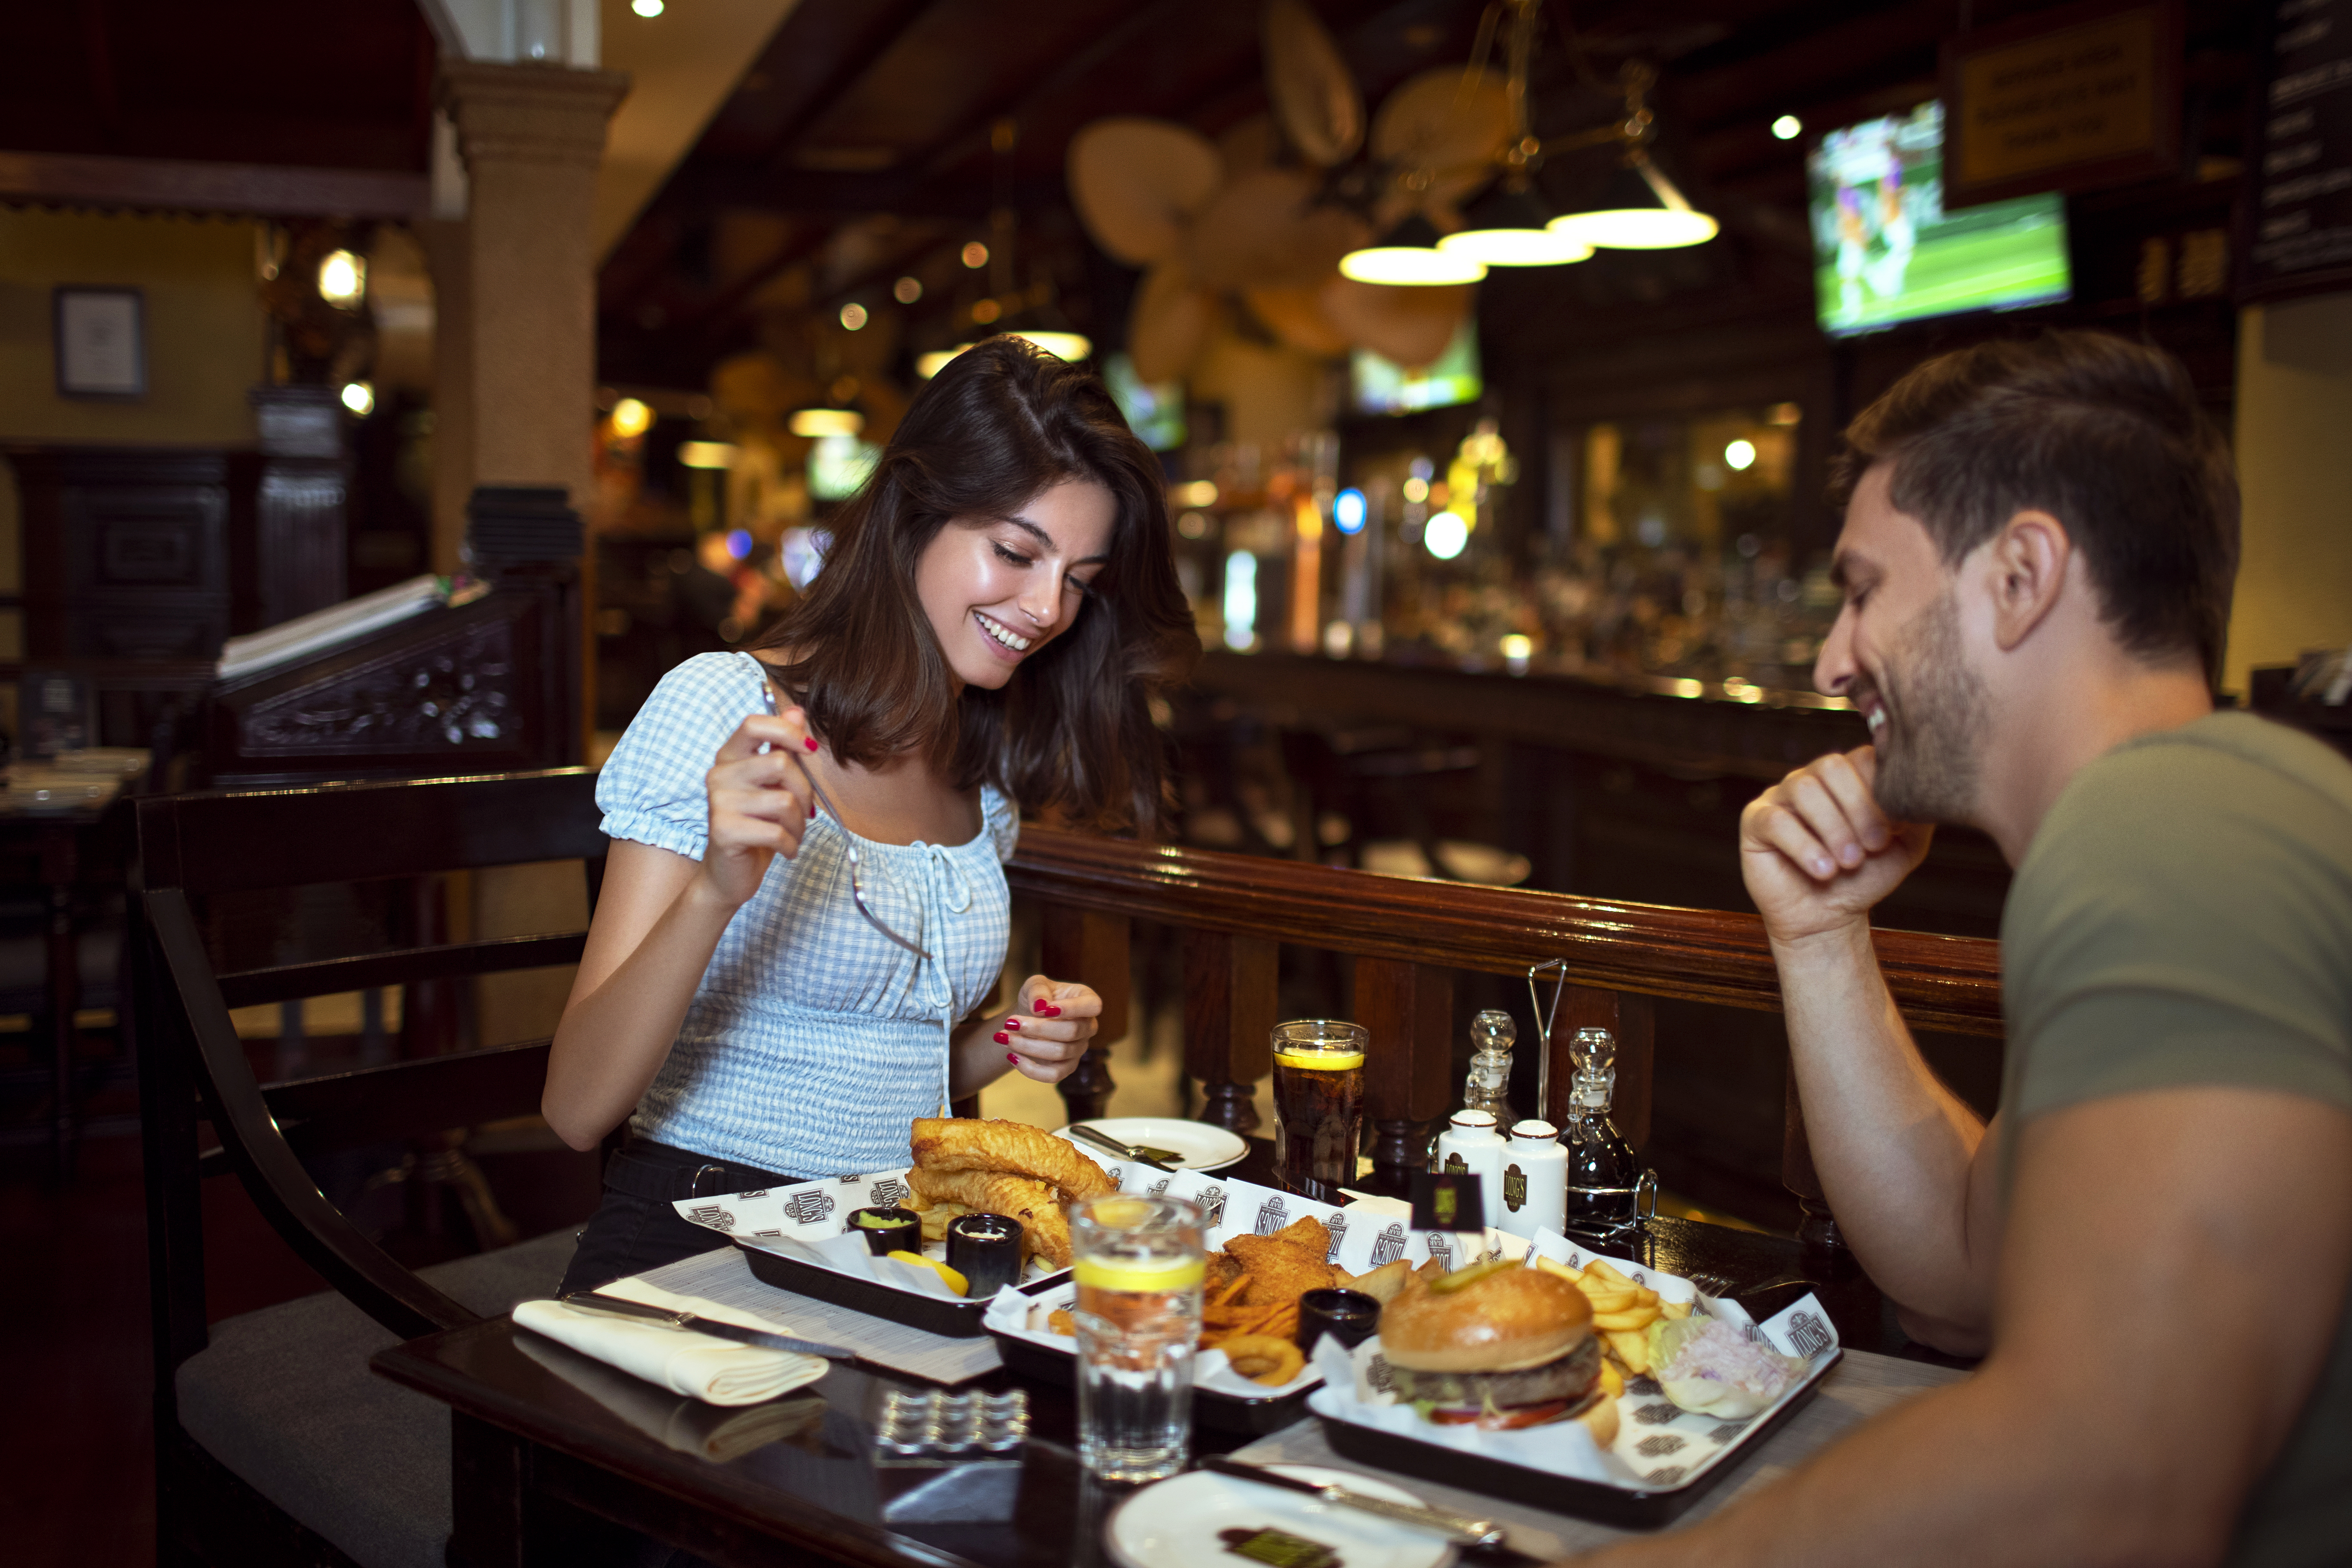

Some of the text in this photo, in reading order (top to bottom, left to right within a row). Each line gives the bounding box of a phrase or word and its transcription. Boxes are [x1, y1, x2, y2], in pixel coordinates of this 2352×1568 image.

[879, 1181, 900, 1207] LONGS
[1505, 1175, 1524, 1198] LONG'S
[798, 1192, 824, 1222] LONG'S
[1270, 1201, 1282, 1209] BAR
[1372, 1239, 1403, 1265] LONG'S
[1790, 1320, 1828, 1359] LONG'S
